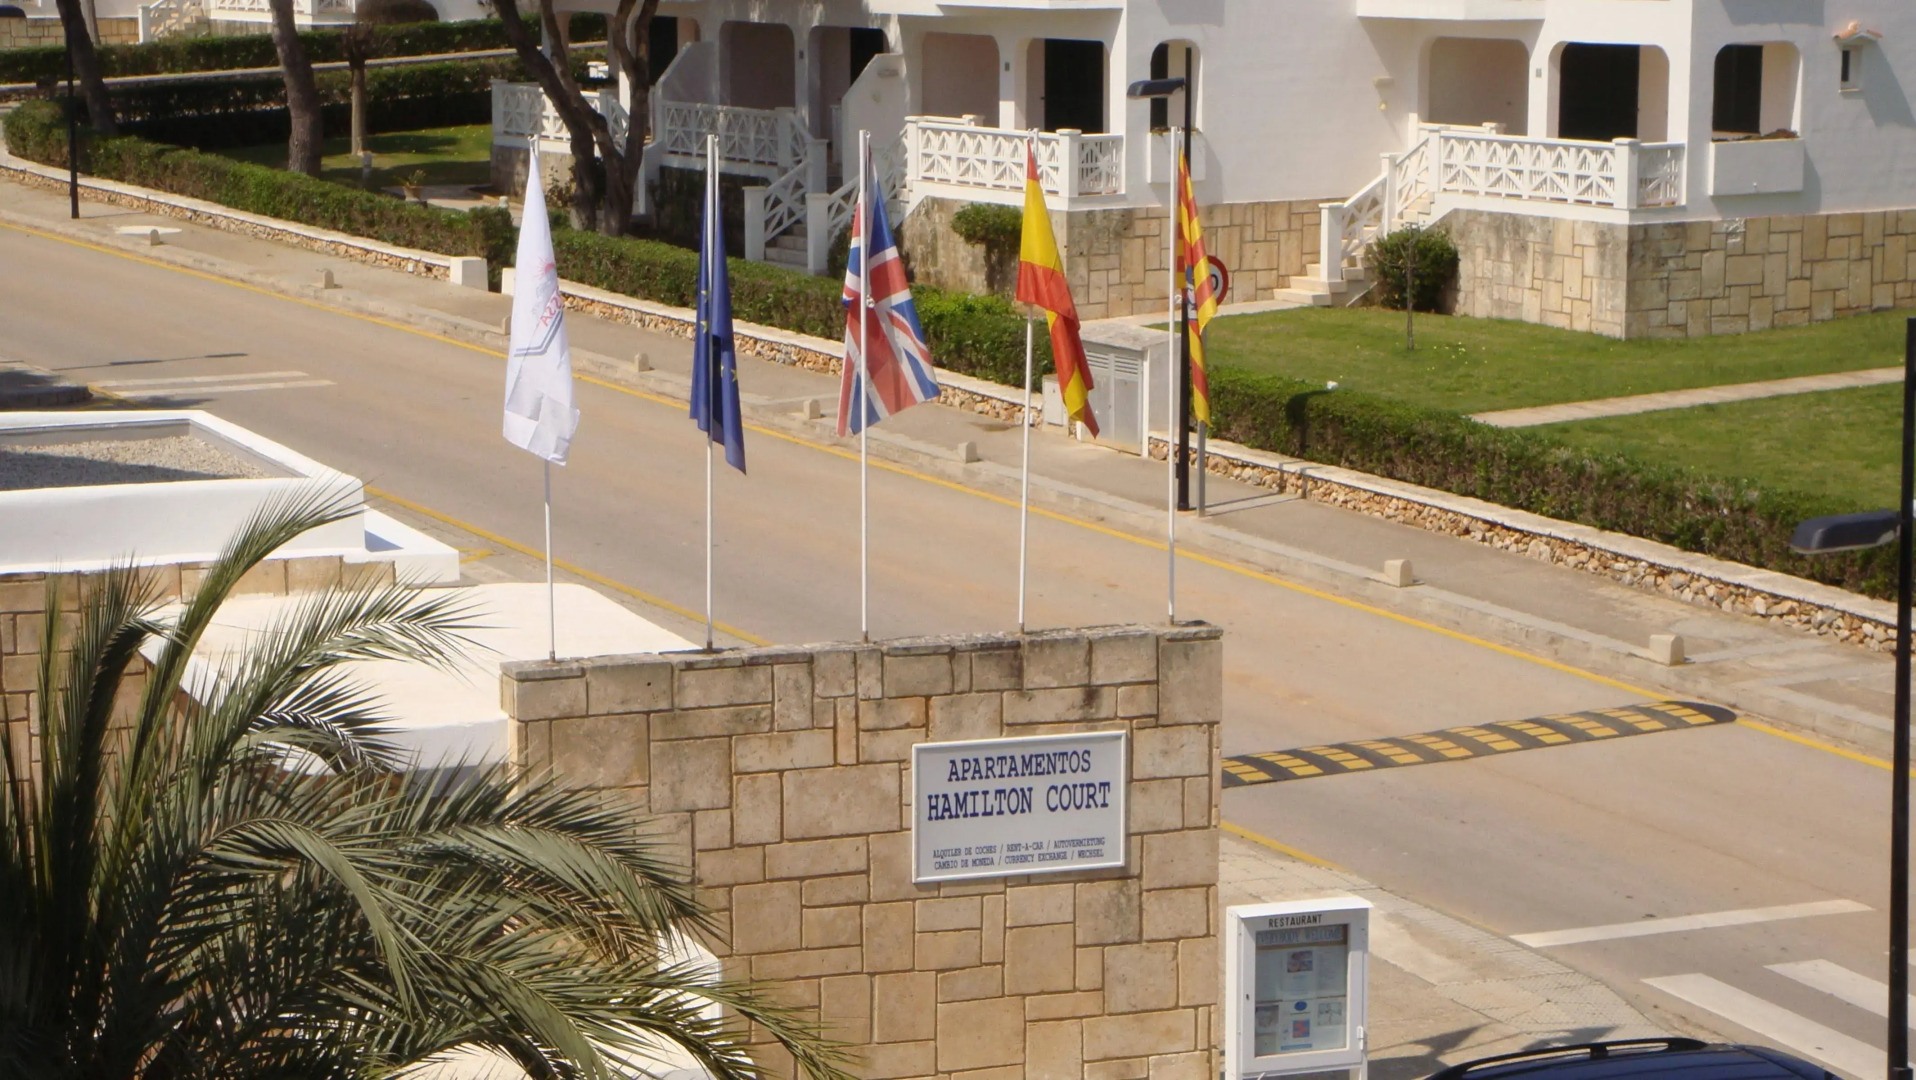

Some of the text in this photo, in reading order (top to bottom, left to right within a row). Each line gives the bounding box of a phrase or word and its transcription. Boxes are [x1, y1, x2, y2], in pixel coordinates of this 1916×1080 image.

[948, 750, 1091, 782] APARTAMENTOS
[927, 781, 1111, 821] HAMILTON COURT
[933, 848, 962, 859] ALQUILER
[965, 846, 973, 856] DE
[975, 845, 998, 855] COCHES
[1006, 841, 1044, 852] RENT-A-CAR
[1053, 836, 1106, 849] AUTOVERMIETUNG
[934, 860, 958, 871] CAMBIO
[961, 859, 969, 868] DE
[972, 857, 995, 867] MONEDA
[1004, 853, 1035, 865] CURRENCY
[1038, 851, 1068, 862] EXCHANGE
[1077, 848, 1105, 858] WECHSEL
[1268, 914, 1322, 928] RESTAURANT
